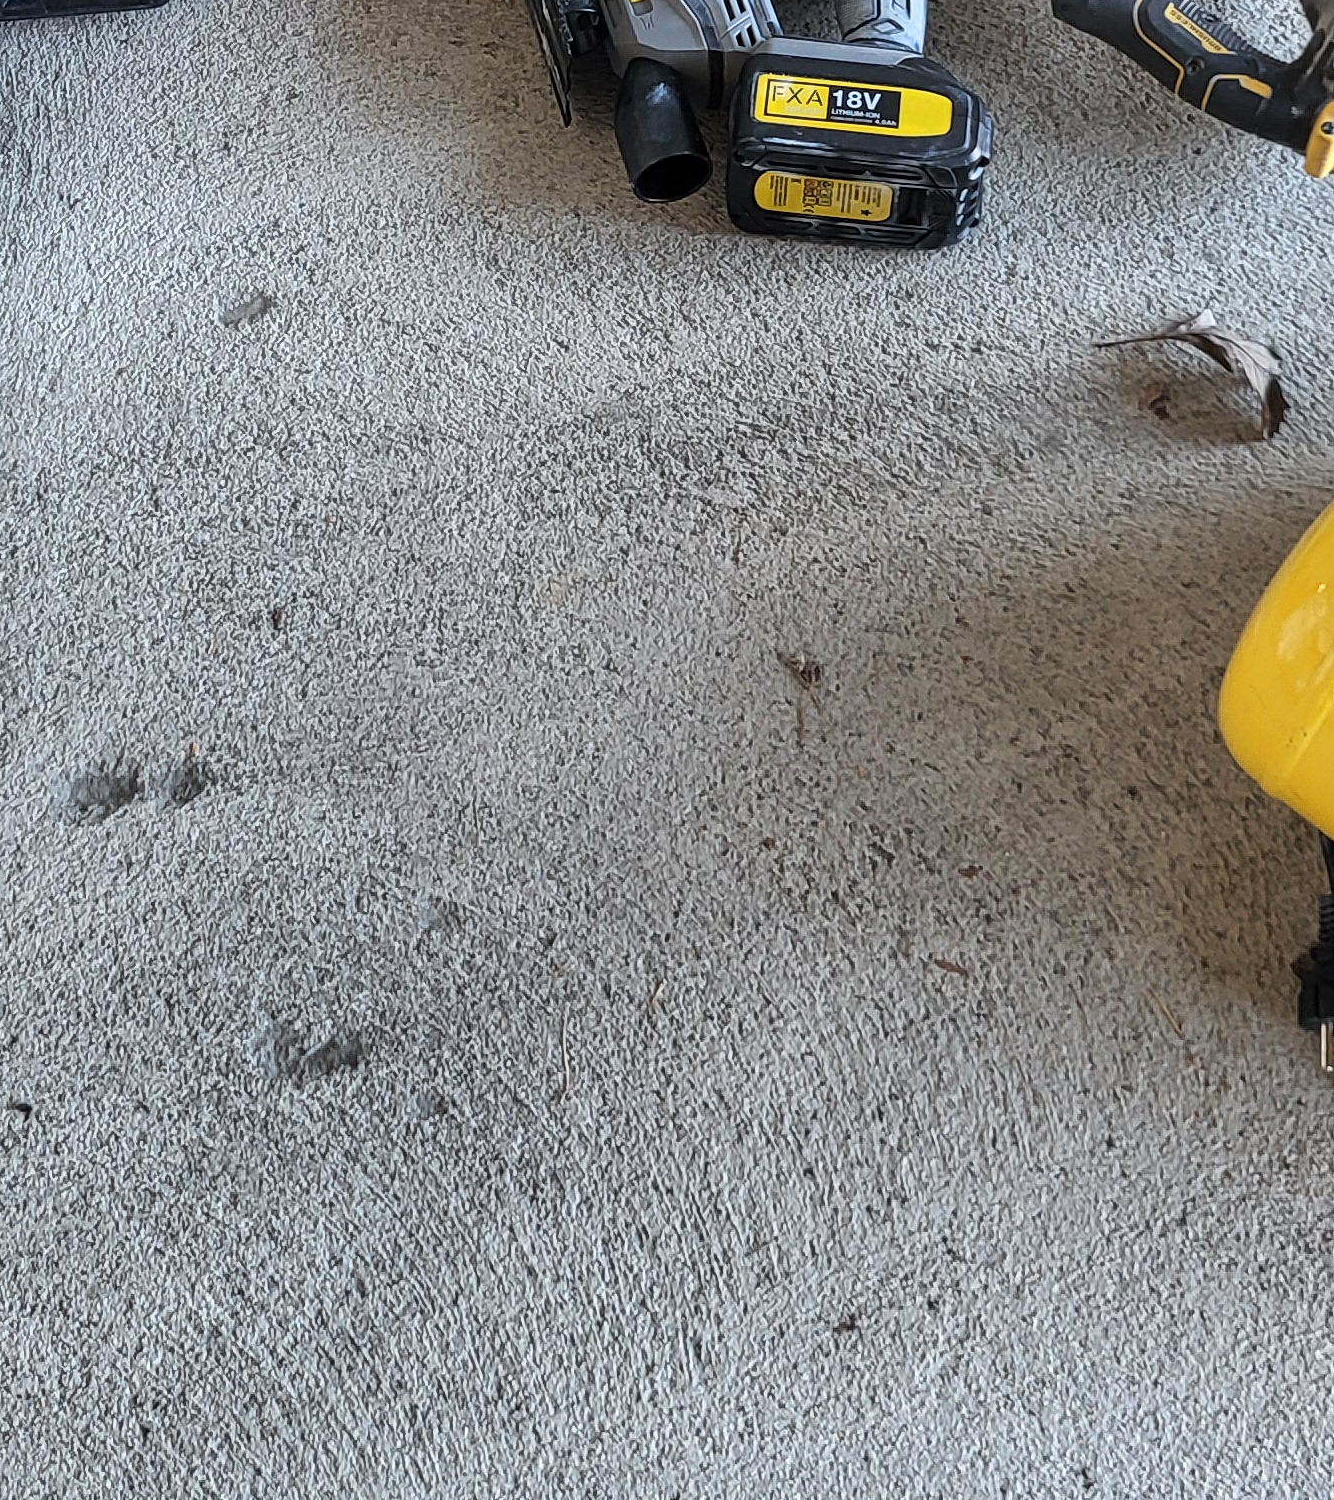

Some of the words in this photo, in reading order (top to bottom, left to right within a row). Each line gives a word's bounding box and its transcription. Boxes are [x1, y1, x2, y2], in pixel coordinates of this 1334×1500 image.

[771, 85, 824, 107] FXA
[832, 90, 882, 110] 18V
[831, 108, 881, 119] LITHIUM-ION
